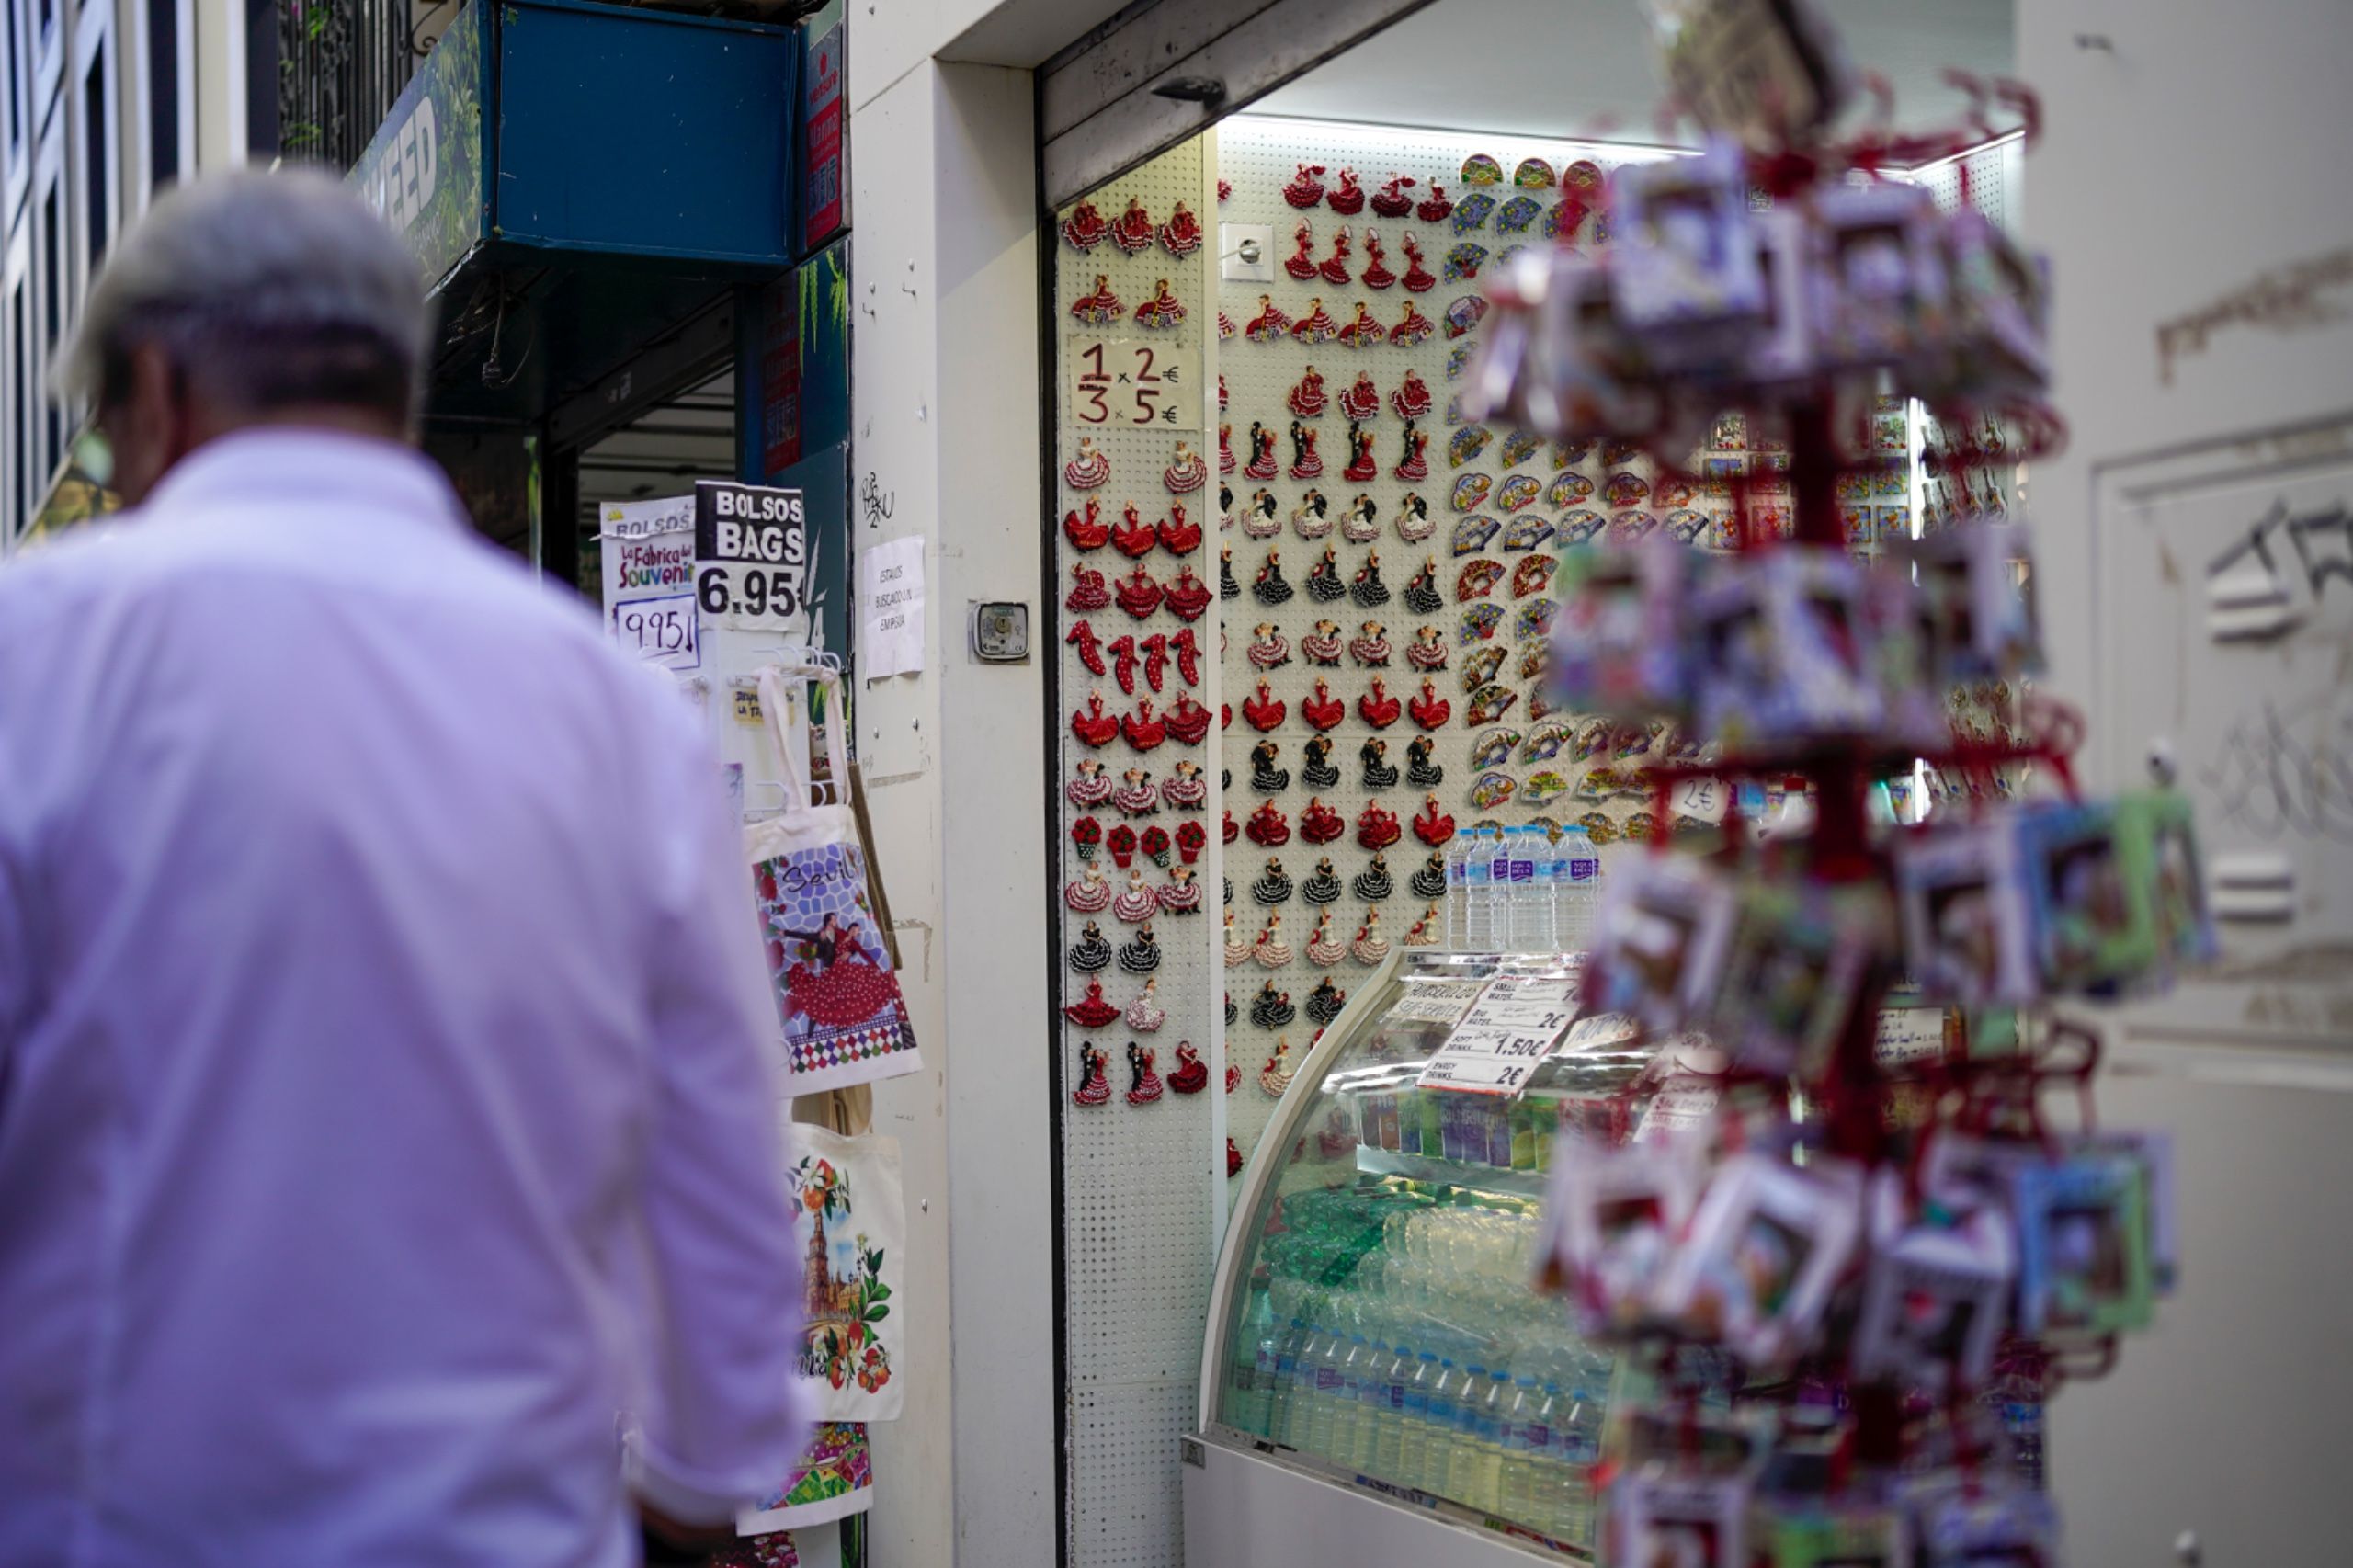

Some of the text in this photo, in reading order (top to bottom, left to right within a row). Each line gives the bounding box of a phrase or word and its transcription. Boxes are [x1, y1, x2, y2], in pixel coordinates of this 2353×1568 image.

[1081, 343, 1111, 381] 1
[1078, 383, 1108, 423] 3
[716, 491, 802, 523] BOLSOS
[616, 513, 690, 536] BOLSOS
[717, 521, 803, 563] BAGS
[1684, 779, 1715, 812] 2€
[1538, 1012, 1566, 1029] 2€
[1494, 1038, 1546, 1056] 1.50€
[1496, 1066, 1524, 1086] 2€
